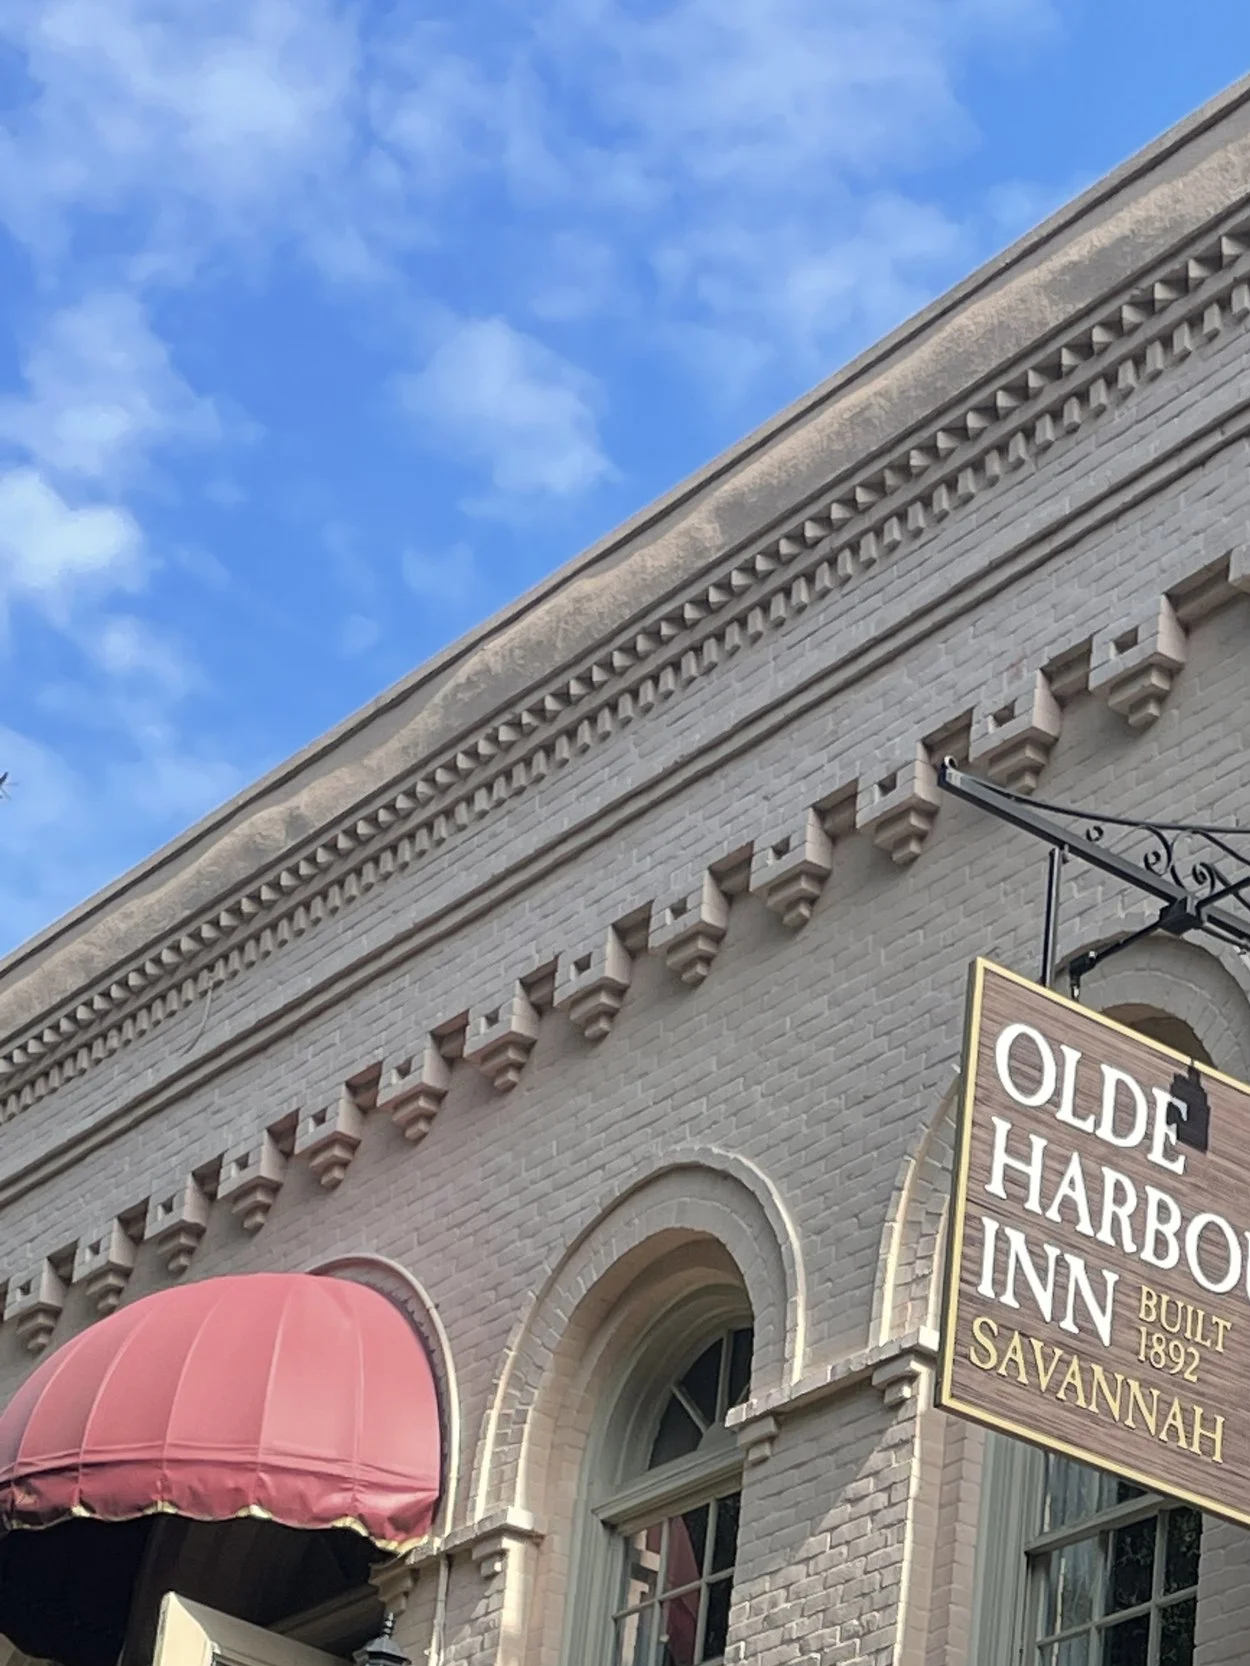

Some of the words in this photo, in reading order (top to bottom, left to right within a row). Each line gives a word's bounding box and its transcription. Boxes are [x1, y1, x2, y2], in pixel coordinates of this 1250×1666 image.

[994, 1022, 1188, 1175] OLDE
[976, 1216, 1120, 1348] INN
[1138, 1284, 1233, 1354] BUILT
[968, 1316, 1226, 1465] SAVANNAH
[1137, 1326, 1201, 1384] 1892
